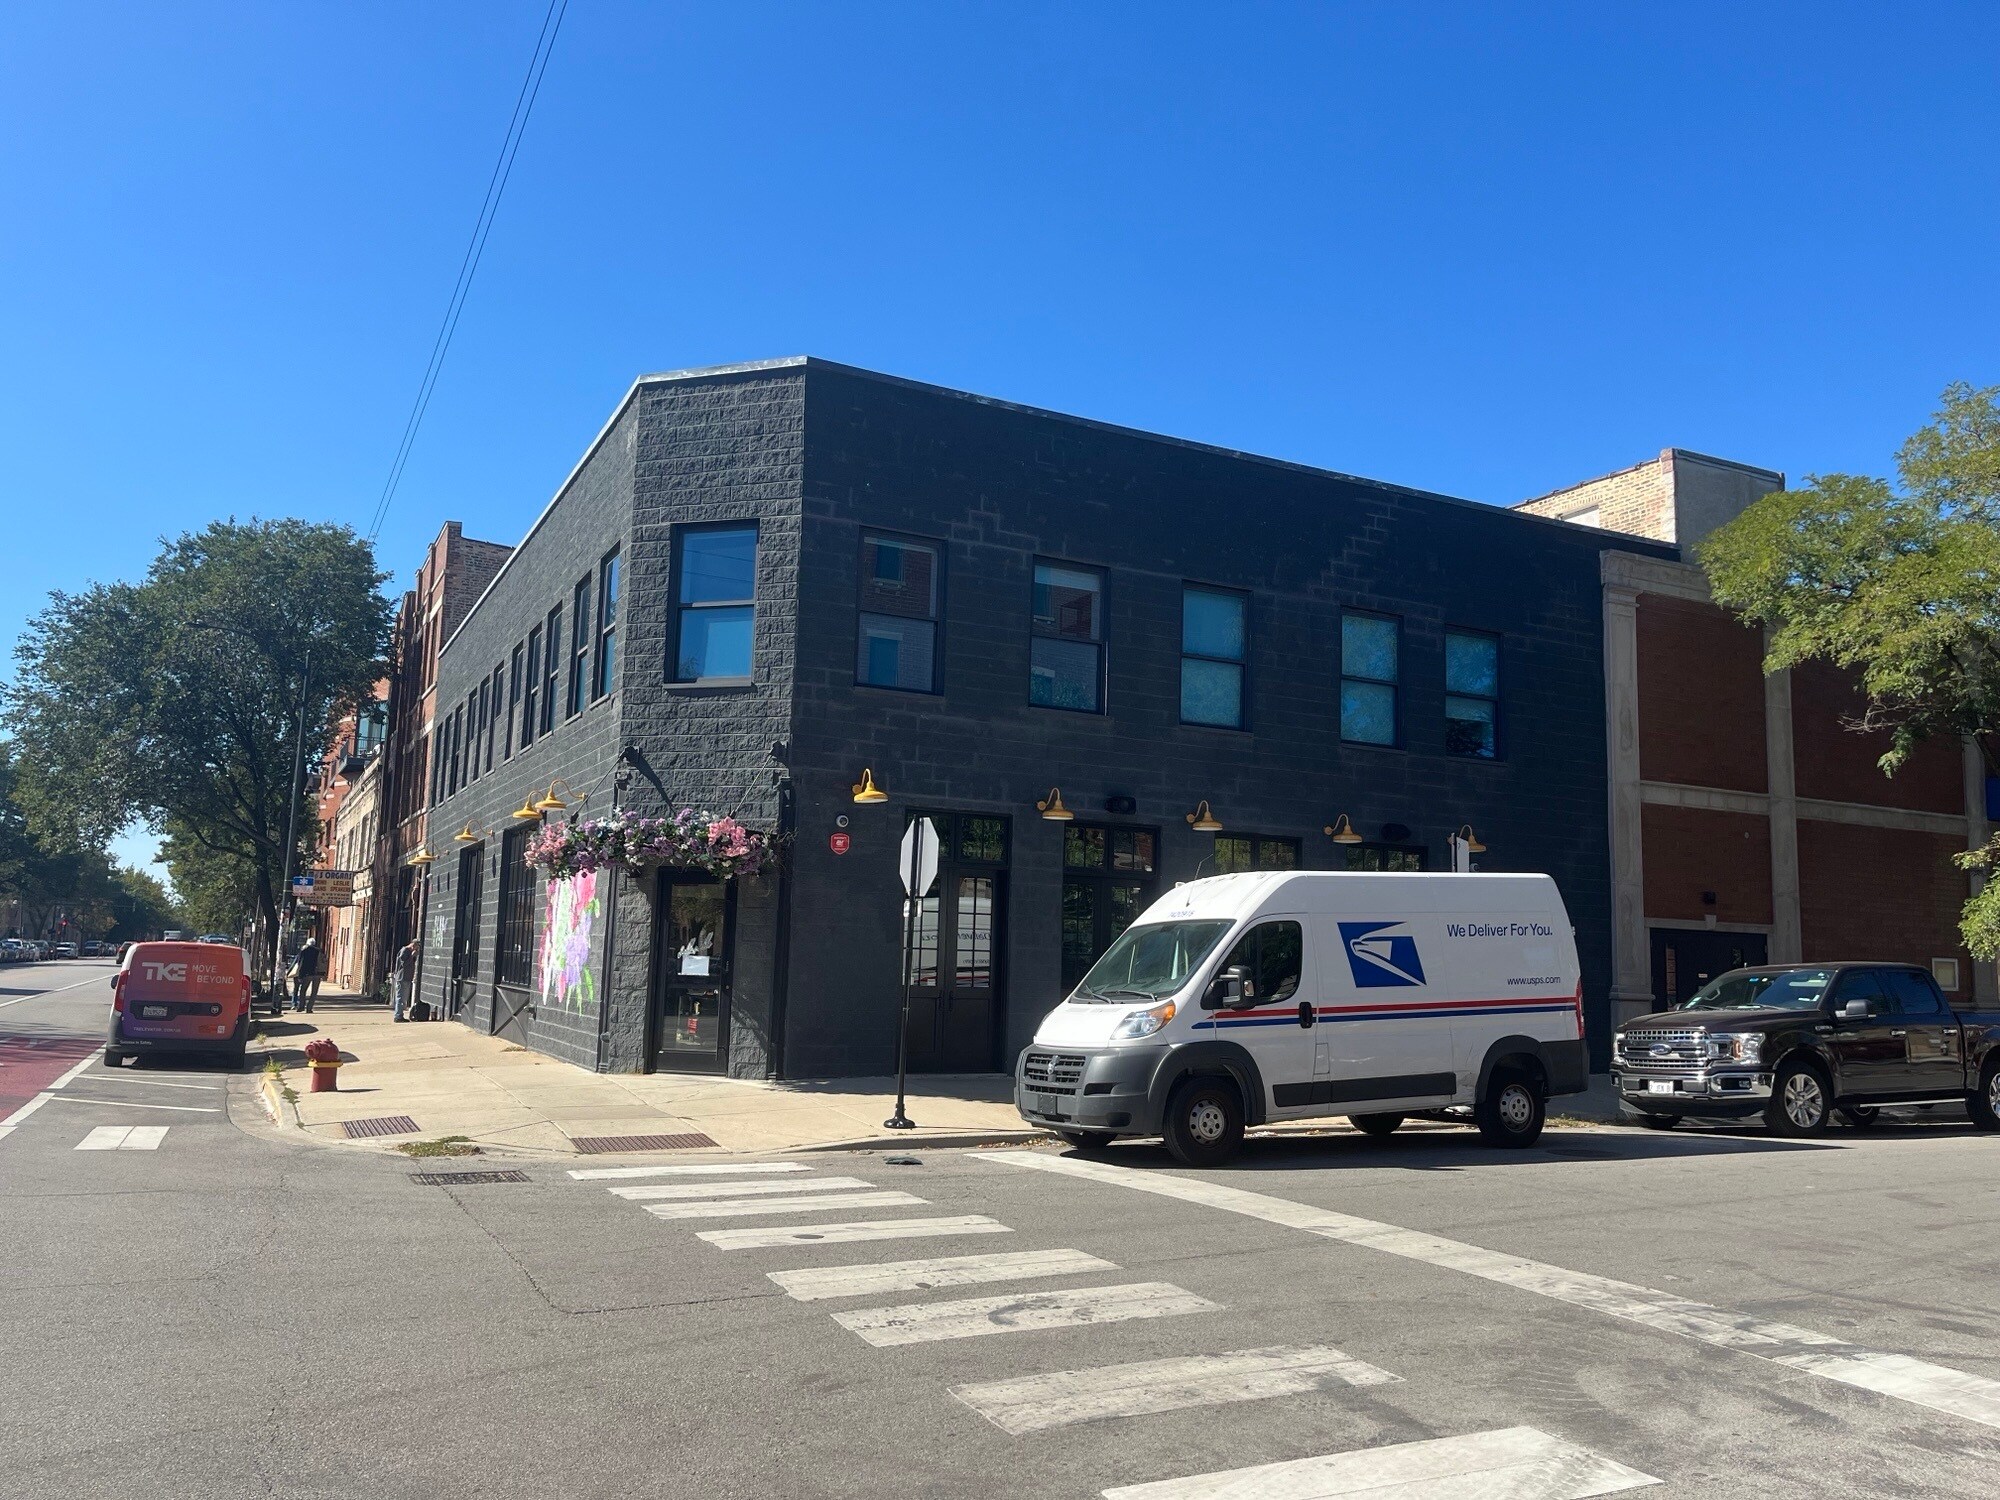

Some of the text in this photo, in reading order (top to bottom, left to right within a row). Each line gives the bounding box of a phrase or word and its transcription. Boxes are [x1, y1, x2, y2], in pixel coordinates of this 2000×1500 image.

[325, 872, 352, 880] ORGANS
[1447, 923, 1553, 938] We Deliver For You.
[142, 961, 188, 982] TKE
[192, 964, 218, 973] MOVE
[196, 974, 234, 984] BEYOND
[1507, 976, 1561, 986] www.usps.com
